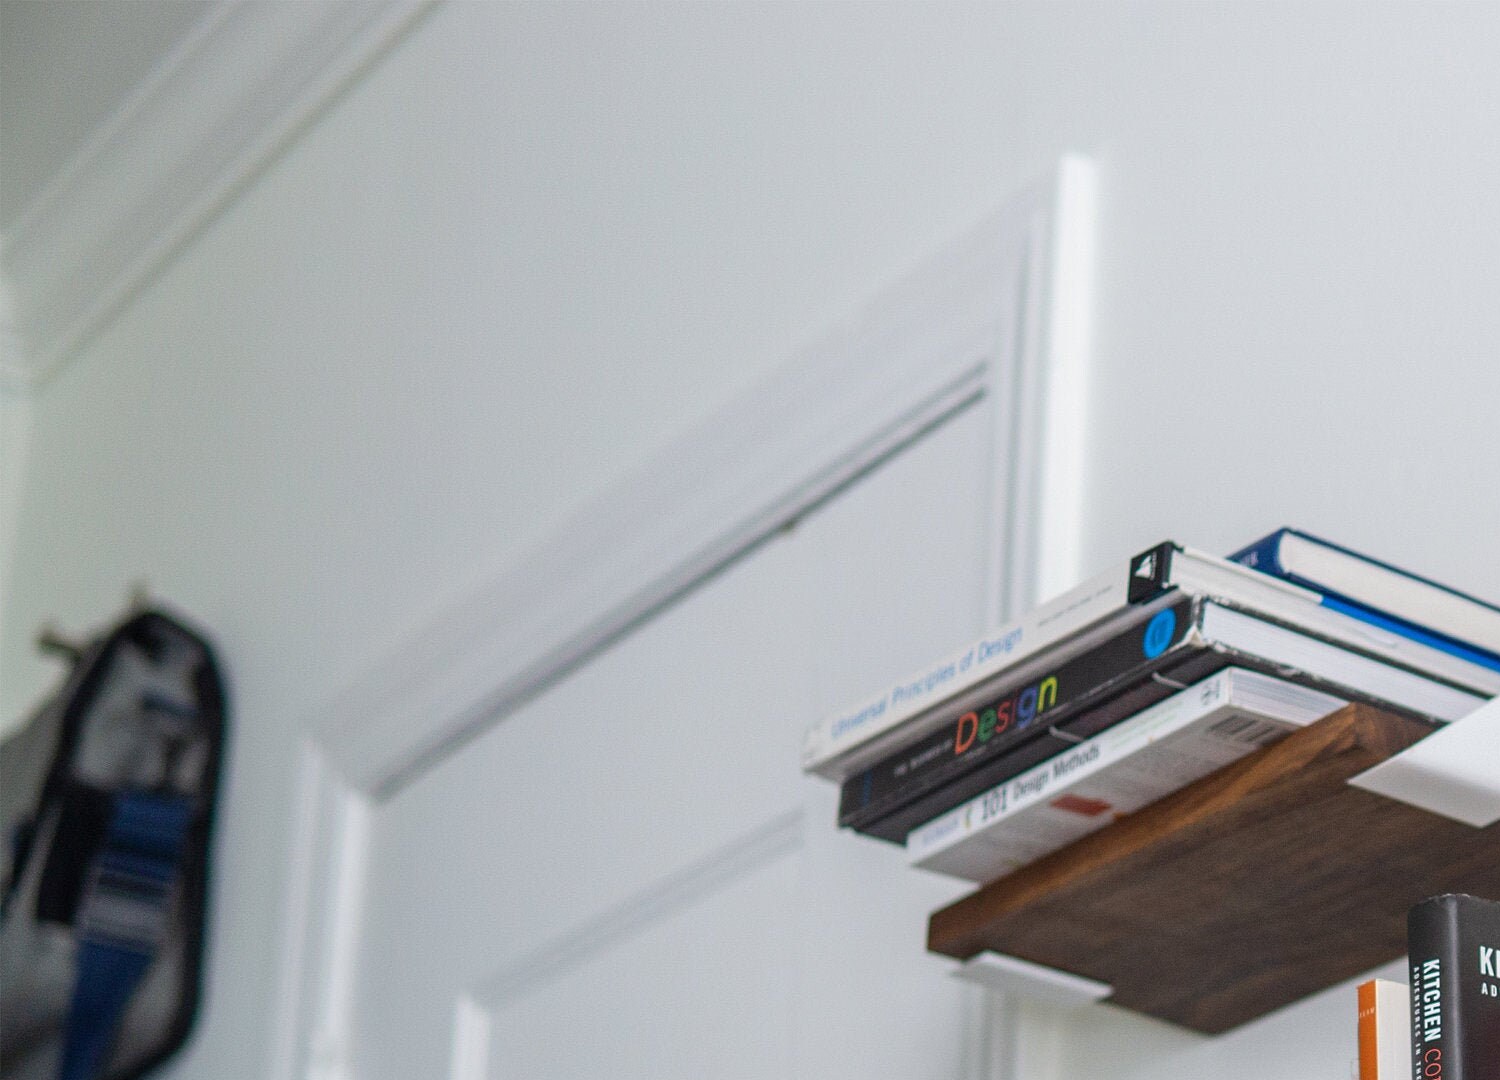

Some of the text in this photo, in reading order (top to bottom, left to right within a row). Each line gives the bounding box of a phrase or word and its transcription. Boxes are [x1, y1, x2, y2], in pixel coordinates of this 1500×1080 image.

[892, 662, 956, 707] Principles
[959, 648, 974, 673] of
[977, 626, 1023, 664] Design
[954, 676, 1058, 756] Design
[982, 743, 1101, 821] 101 Design Methods
[1413, 966, 1421, 1038] ADVENTURES
[1423, 958, 1442, 1043] KITCHEN
[1415, 1043, 1422, 1056] IN
